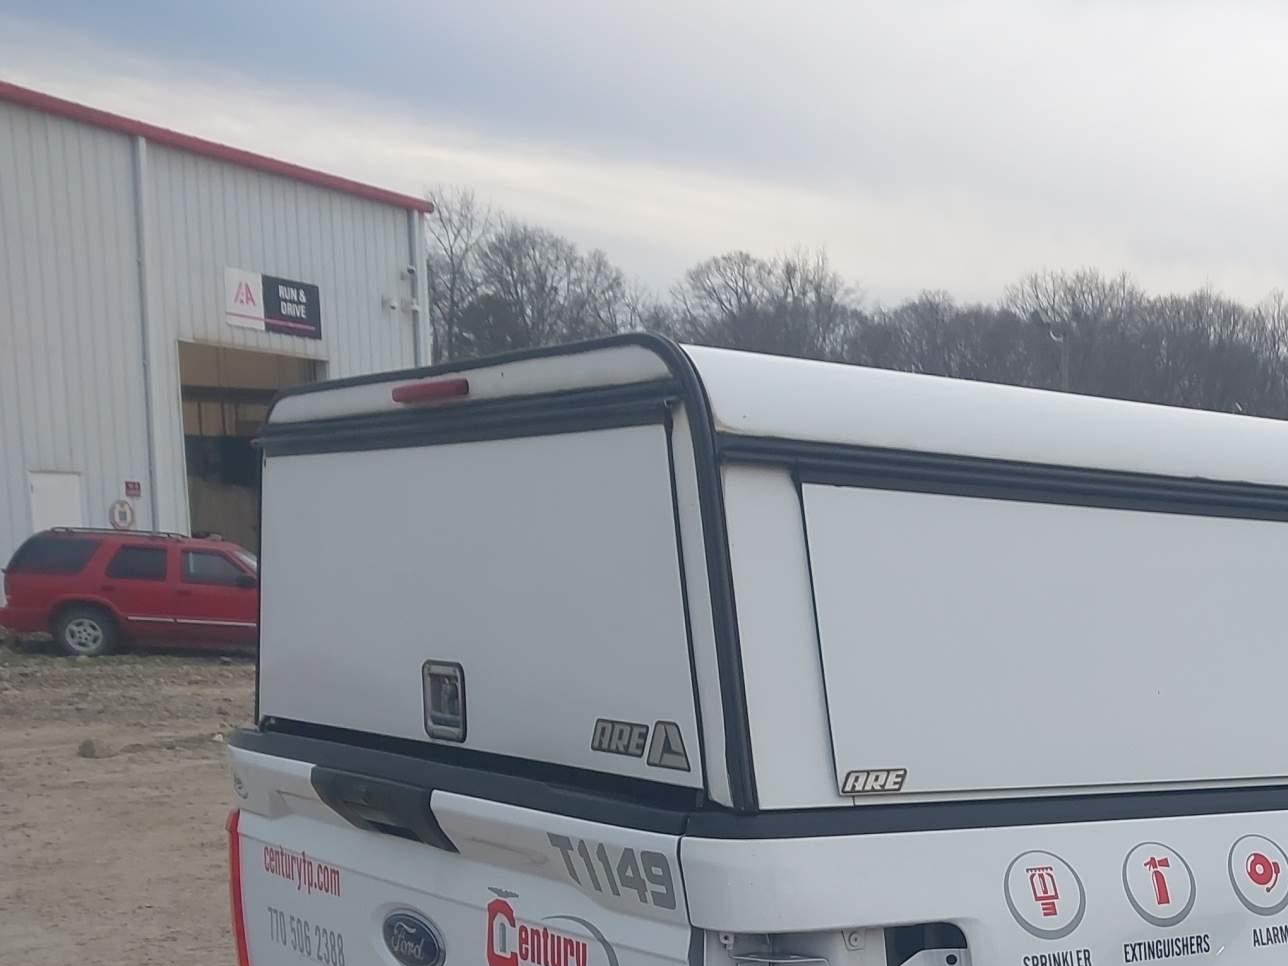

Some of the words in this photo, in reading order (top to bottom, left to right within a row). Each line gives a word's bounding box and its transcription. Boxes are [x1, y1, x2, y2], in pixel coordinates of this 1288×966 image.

[279, 285, 297, 301] RUN
[299, 289, 306, 303] &
[281, 301, 306, 319] DRIVE
[594, 721, 647, 754] ARE
[846, 770, 905, 792] ARE
[263, 846, 341, 897] centuryfp.com
[547, 832, 677, 910] T1149
[267, 906, 286, 946] 770
[290, 915, 311, 957] 506
[392, 922, 425, 960] Ford
[1123, 934, 1210, 963] EXTINGUISHERS
